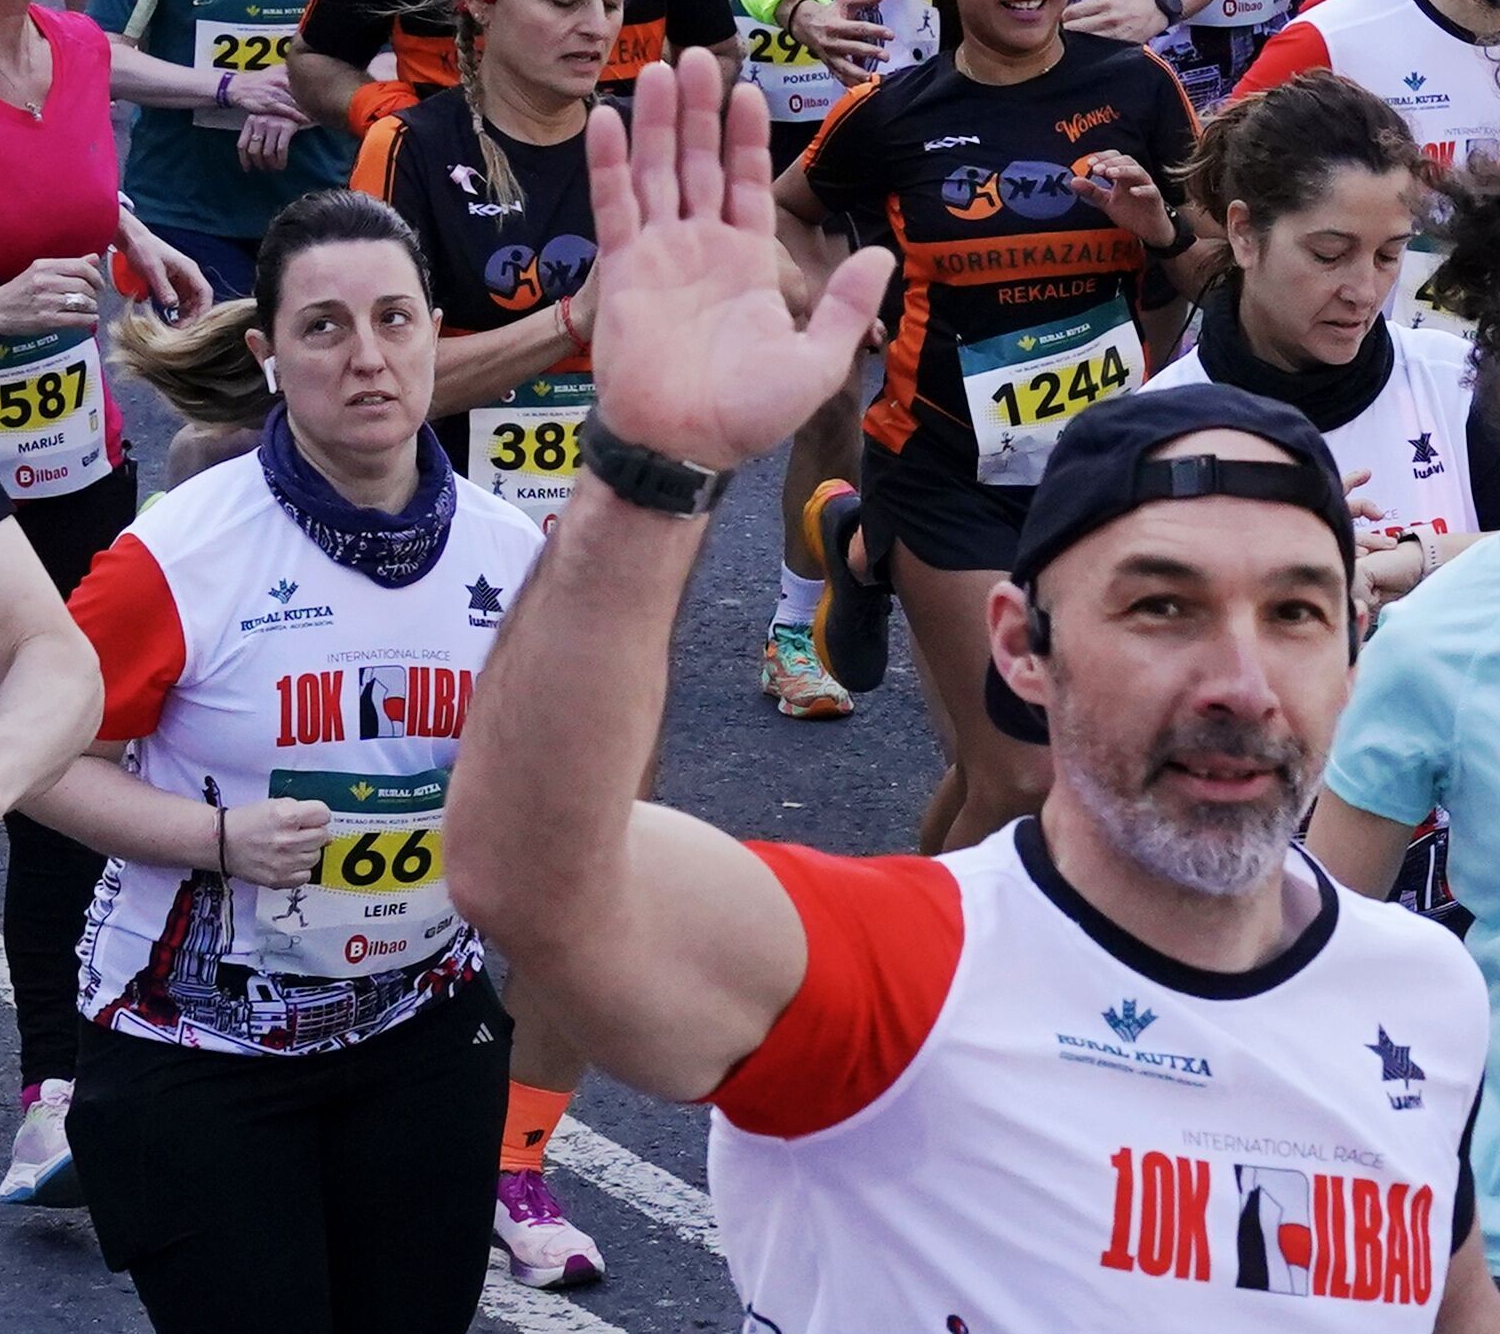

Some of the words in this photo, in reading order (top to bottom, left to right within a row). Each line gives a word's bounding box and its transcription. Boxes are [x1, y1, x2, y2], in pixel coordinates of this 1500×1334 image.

[924, 135, 981, 152] KON
[1054, 107, 1121, 144] WONKA
[998, 278, 1097, 307] REKALDE
[992, 345, 1130, 429] 1244
[16, 431, 65, 454] MARIJE
[275, 671, 345, 747] 10K
[317, 830, 434, 886] 66
[364, 902, 408, 918] LEIRE
[1181, 1130, 1325, 1163] INTERNATIONAL
[1333, 1144, 1385, 1170] RACE
[1099, 1145, 1212, 1283] 10K
